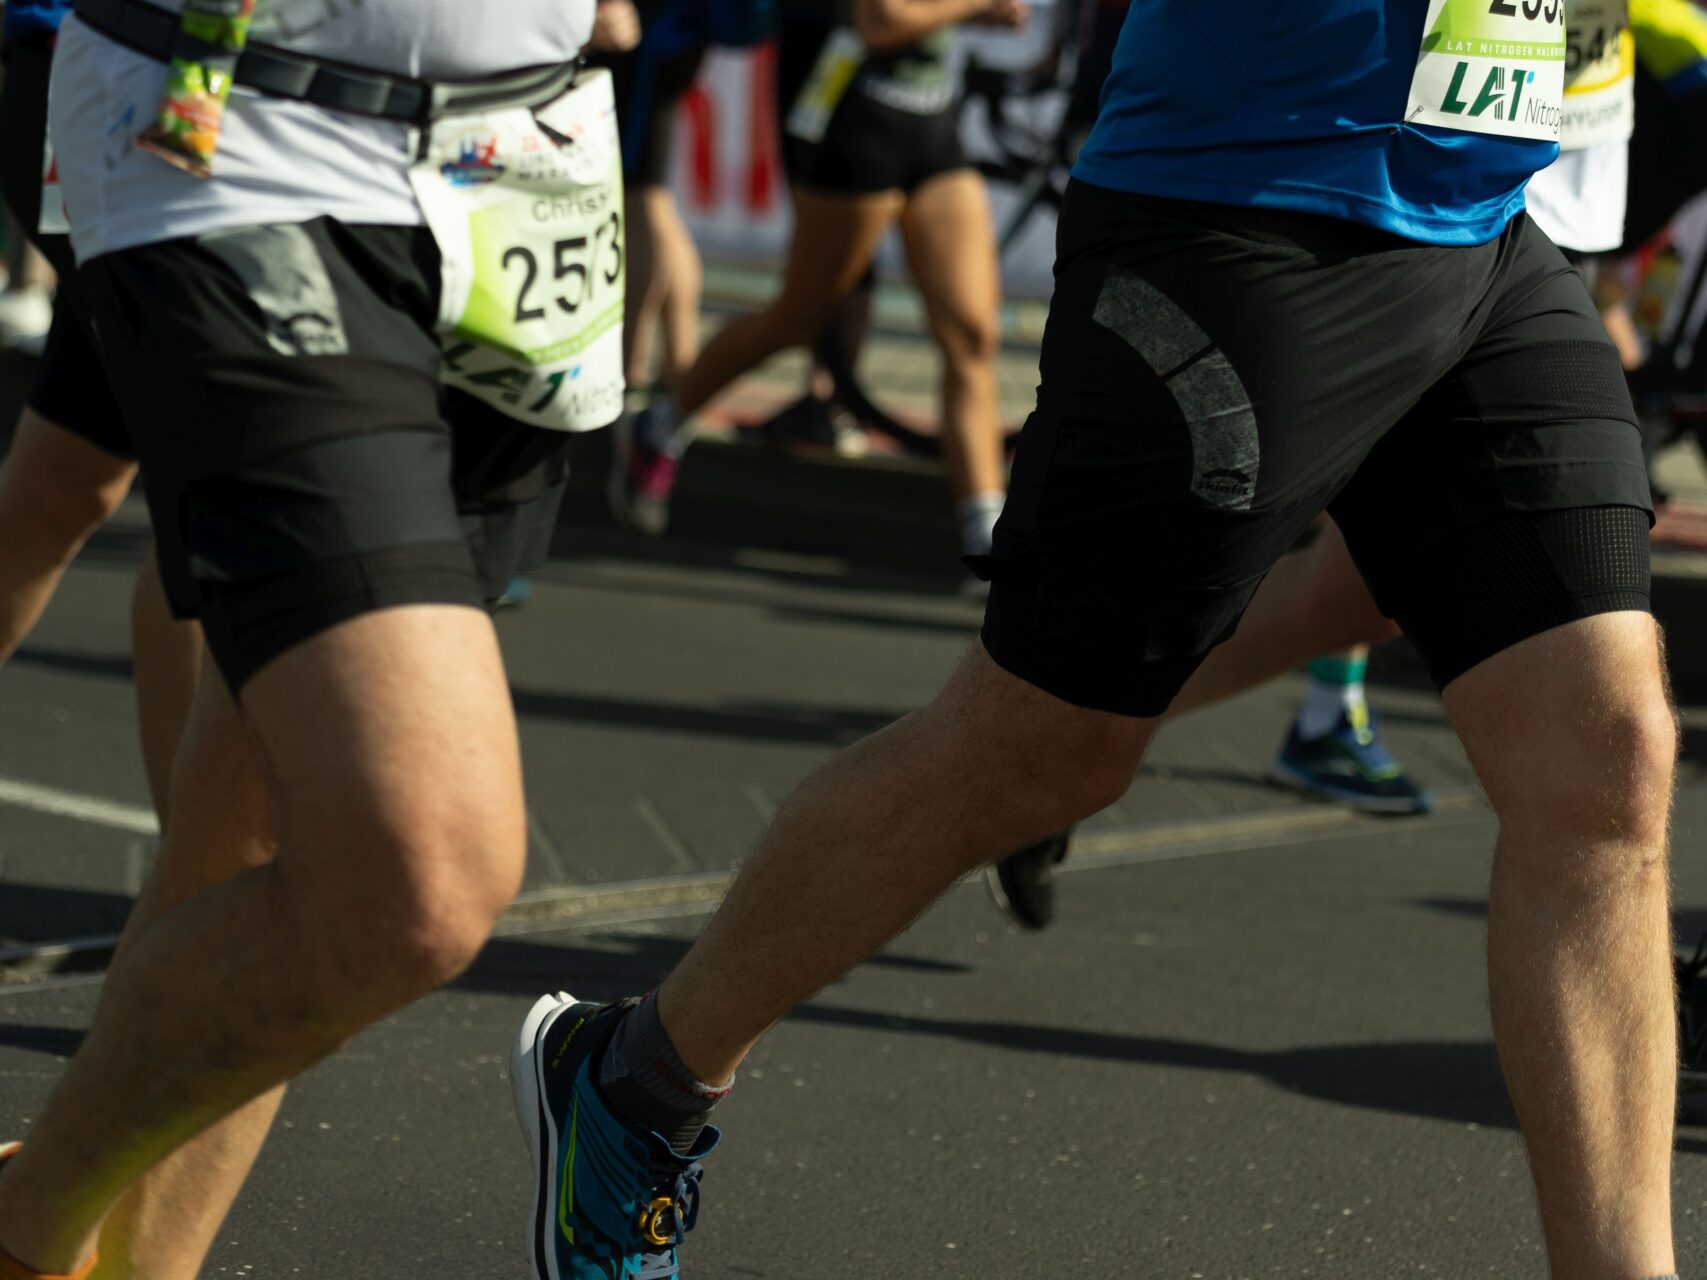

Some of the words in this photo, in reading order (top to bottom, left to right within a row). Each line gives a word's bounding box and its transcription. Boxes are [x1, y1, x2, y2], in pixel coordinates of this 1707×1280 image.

[1446, 40, 1473, 52] LAT
[1480, 43, 1533, 56] NITROGEN
[1439, 61, 1528, 122] LAT
